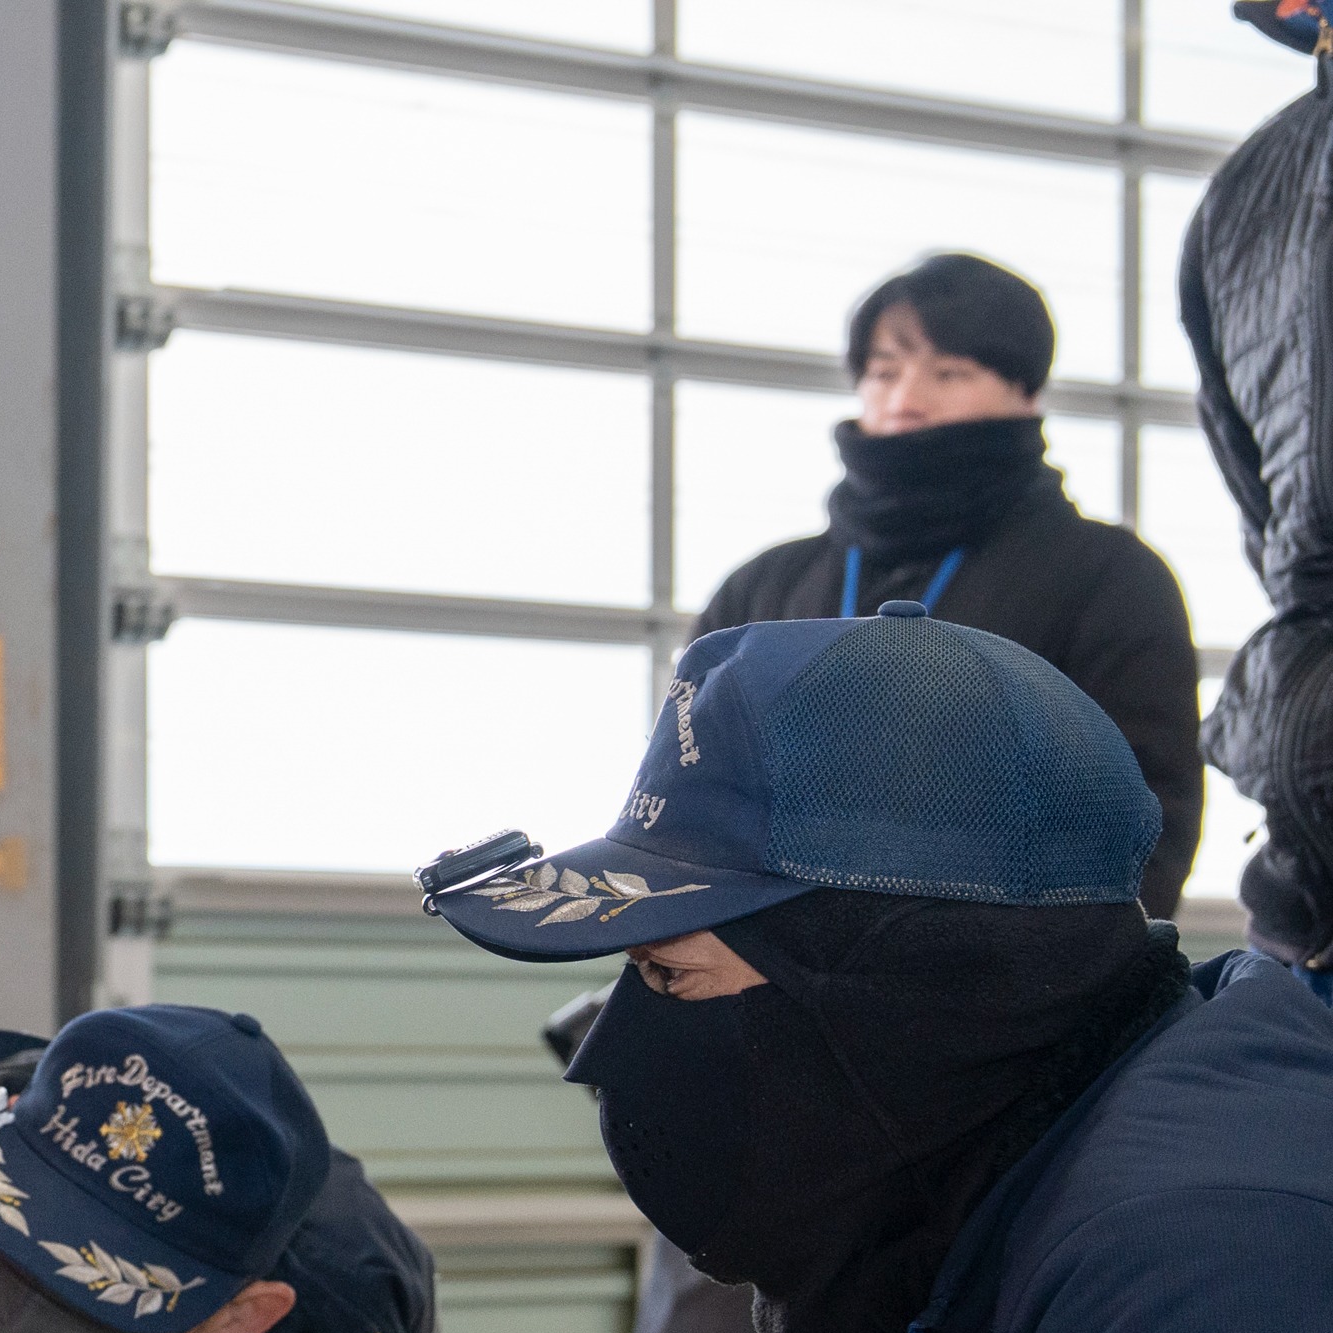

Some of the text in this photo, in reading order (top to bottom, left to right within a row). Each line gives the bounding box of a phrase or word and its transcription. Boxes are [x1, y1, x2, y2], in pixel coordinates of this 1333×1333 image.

[620, 776, 667, 830] ity
[39, 1103, 183, 1223] Hida City
[60, 1053, 225, 1196] Fire Department
